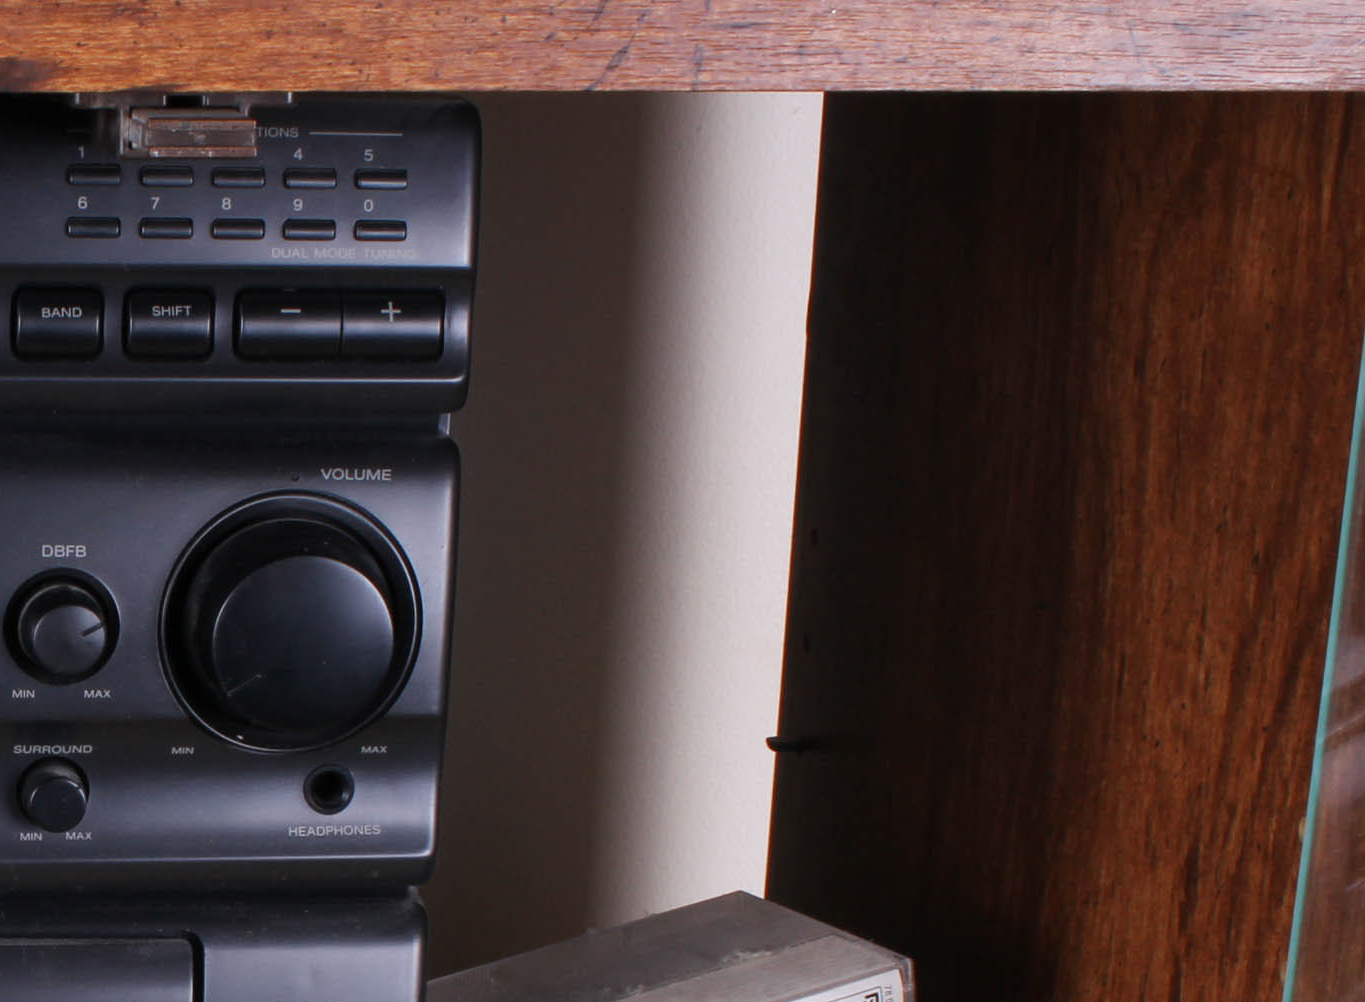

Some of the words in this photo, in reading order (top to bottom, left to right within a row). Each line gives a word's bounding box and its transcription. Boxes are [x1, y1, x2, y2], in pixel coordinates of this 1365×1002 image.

[42, 307, 82, 318] BAND
[152, 306, 191, 316] SHIFT
[321, 468, 391, 480] VOLUME
[42, 545, 86, 557] DBFB
[14, 745, 92, 754] SURROUND
[289, 825, 380, 836] HEADPHONES
